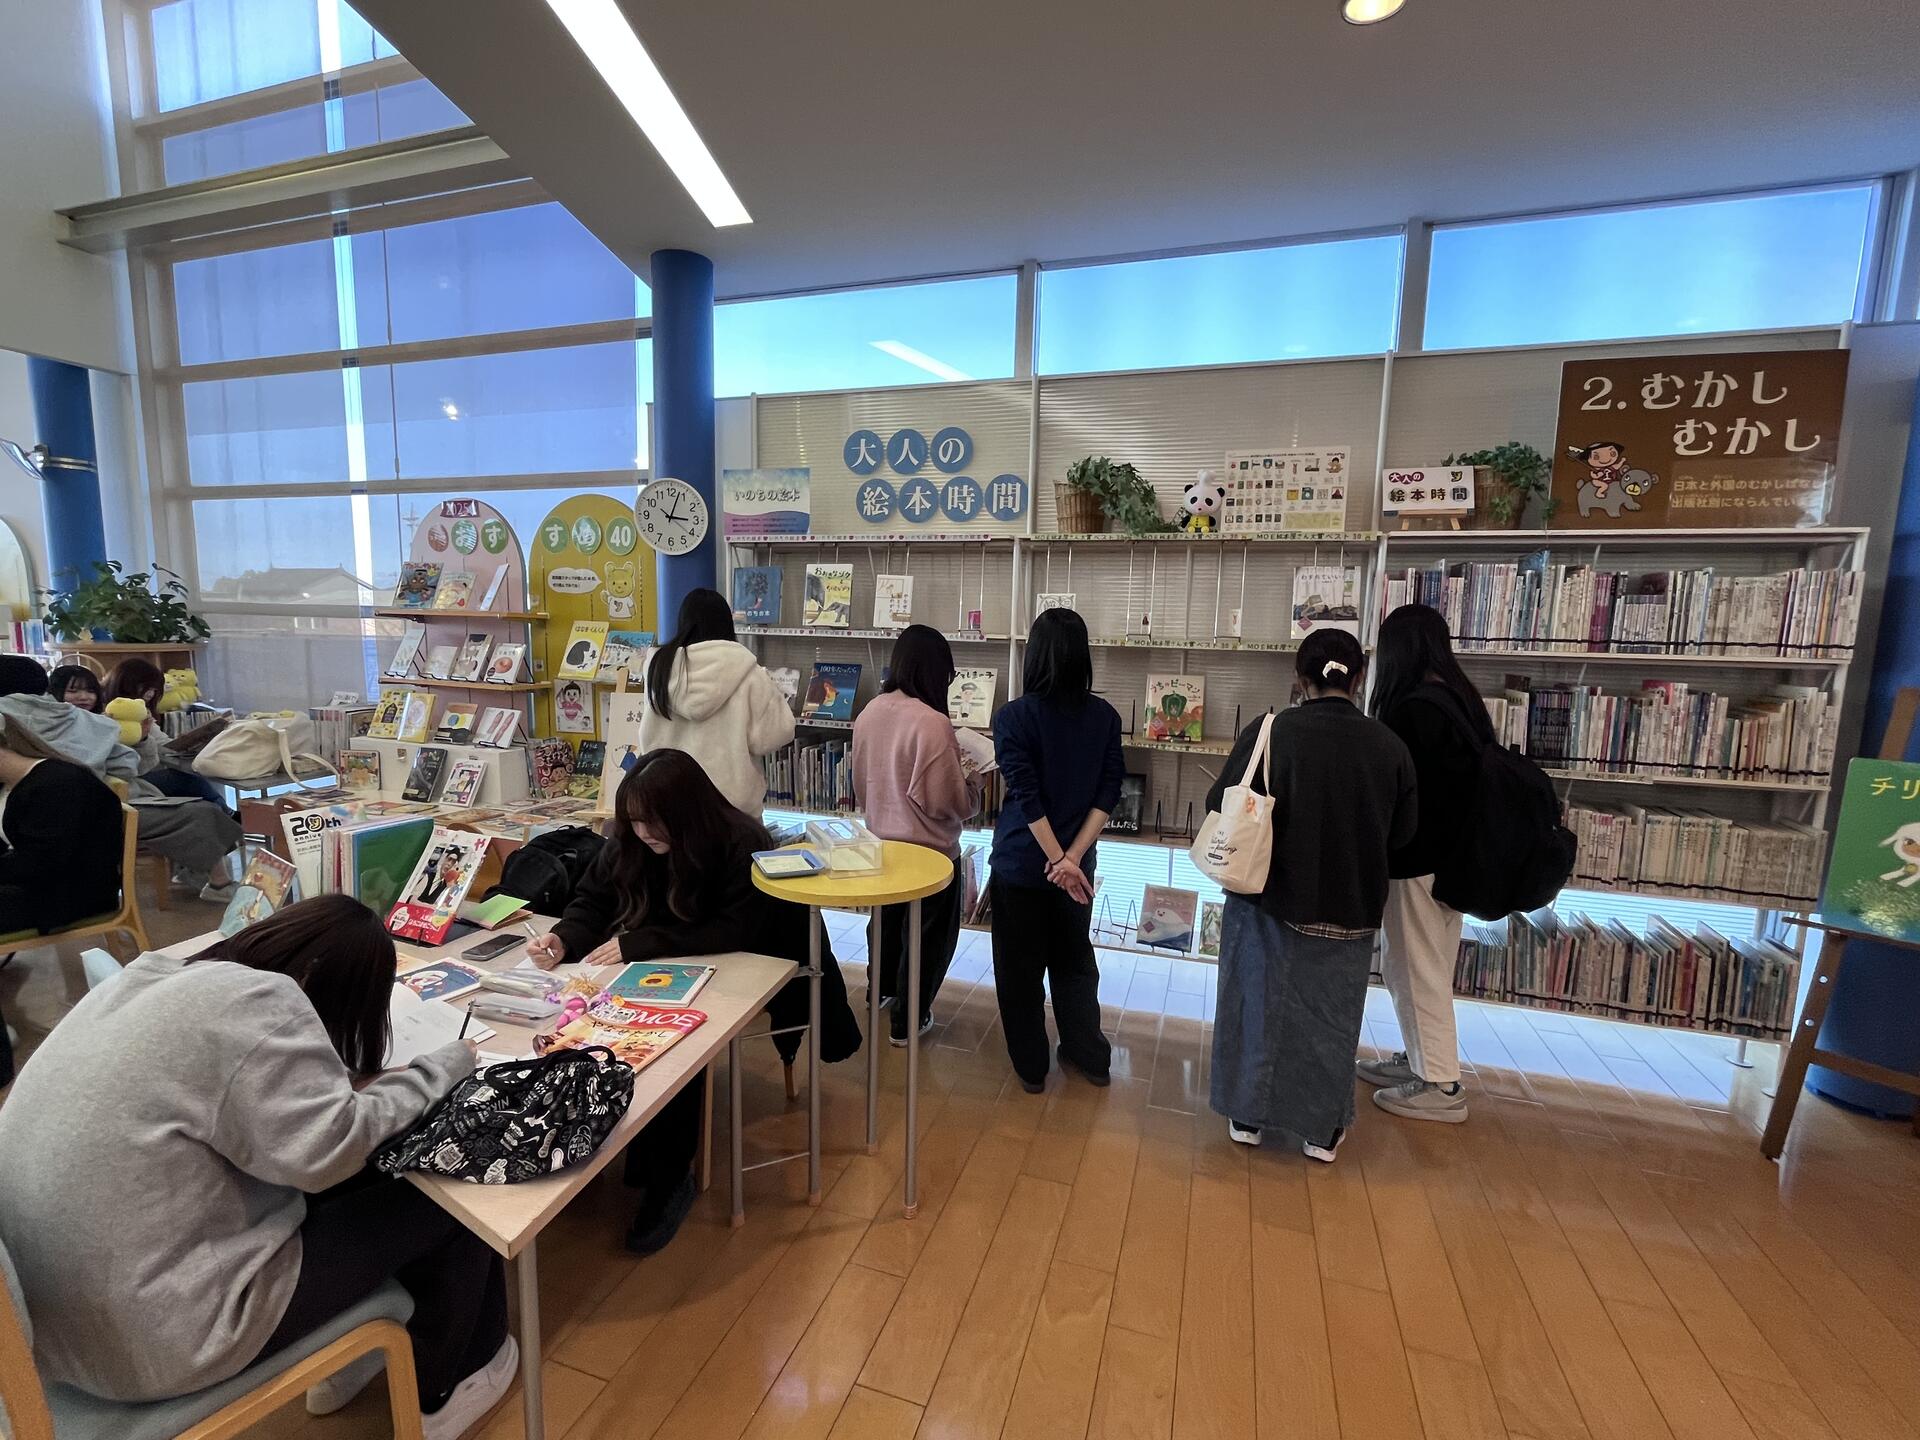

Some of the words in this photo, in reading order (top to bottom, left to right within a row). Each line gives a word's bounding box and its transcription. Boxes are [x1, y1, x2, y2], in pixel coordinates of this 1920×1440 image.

[1672, 417, 1821, 456] むかし
[850, 437, 965, 467] 大人の
[1390, 472, 1422, 485] 大人の
[655, 490, 664, 500] 11
[666, 487, 677, 498] 12
[681, 492, 686, 502] 1
[734, 488, 801, 502] いのちの絵本
[1389, 487, 1468, 502] 絵本時間
[646, 498, 657, 508] 10
[862, 481, 1021, 517] 絵本時間
[689, 502, 696, 513] 2
[643, 510, 650, 520] 9
[693, 515, 700, 525] 3
[647, 523, 654, 533] 8
[688, 527, 695, 537] 4
[657, 532, 663, 542] 7
[668, 536, 675, 547] 6
[680, 535, 687, 545] 5
[1870, 776, 1920, 801] チリ
[629, 1009, 702, 1028] MOE
